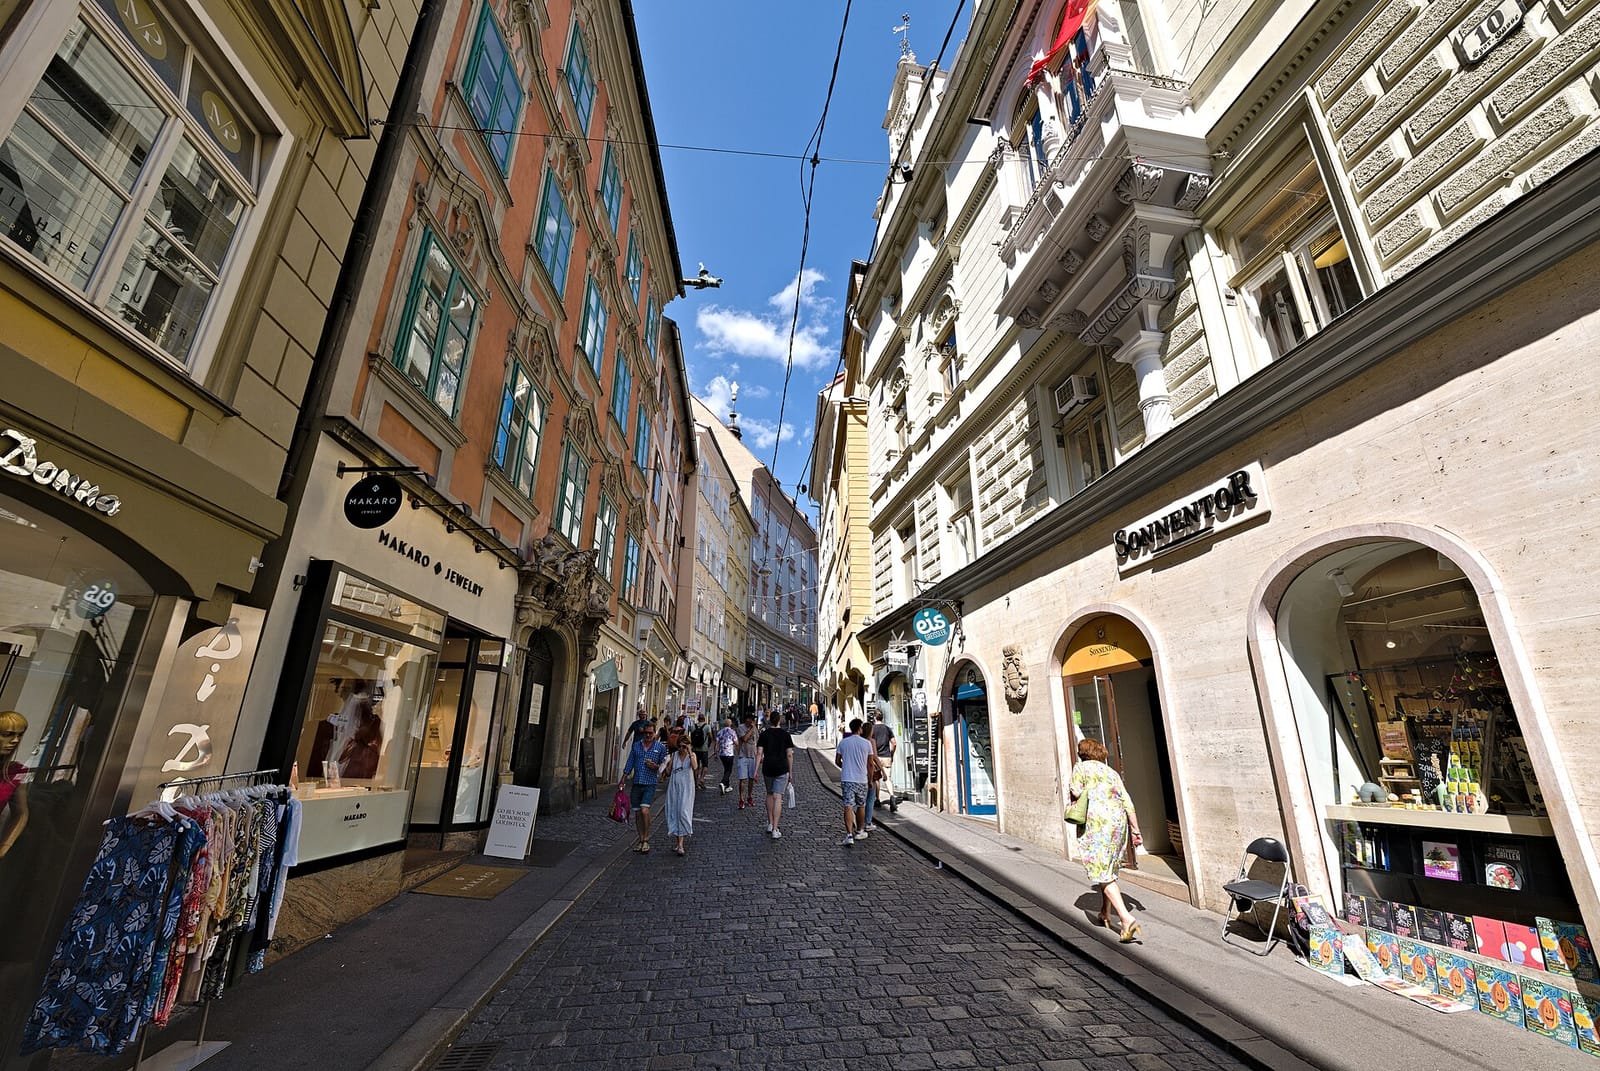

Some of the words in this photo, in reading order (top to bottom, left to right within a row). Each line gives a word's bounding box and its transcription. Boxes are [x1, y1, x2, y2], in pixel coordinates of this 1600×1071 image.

[1474, 9, 1505, 46] 10
[349, 497, 397, 505] MAKARO
[1114, 469, 1258, 557] SONNENTOR
[378, 529, 430, 567] MAKARO
[445, 568, 484, 597] JEWELRY
[916, 611, 946, 635] eis
